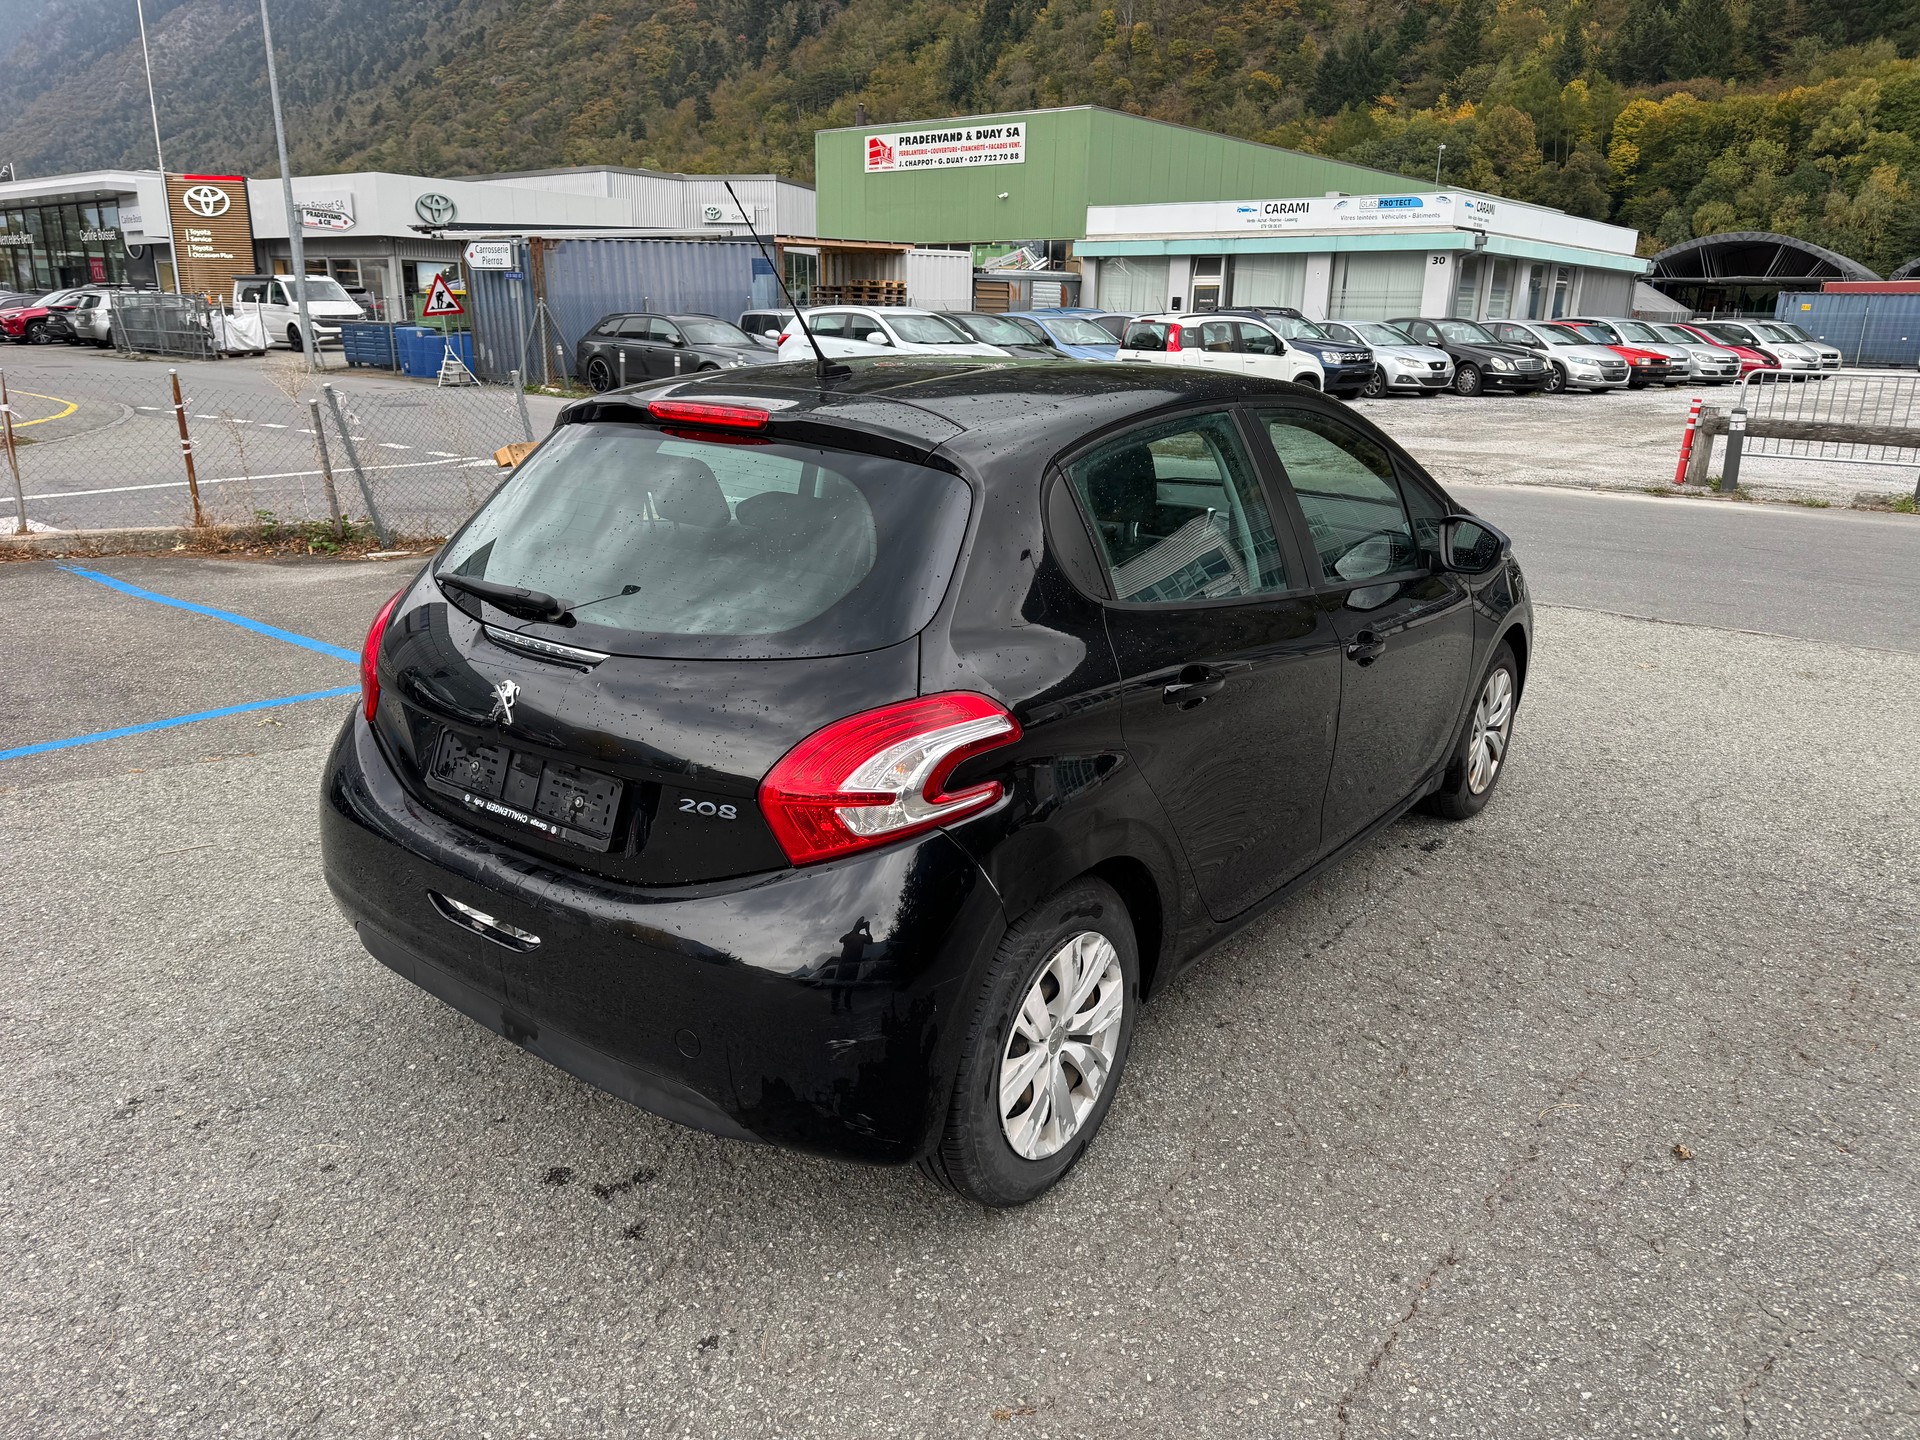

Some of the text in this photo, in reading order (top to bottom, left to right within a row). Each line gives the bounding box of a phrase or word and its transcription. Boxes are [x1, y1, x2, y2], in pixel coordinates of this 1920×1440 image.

[899, 126, 1020, 146] PRADERVAND & DUAY SA
[905, 158, 934, 167] CHAPPOT
[946, 156, 964, 164] DUAY
[969, 155, 982, 163] 027
[984, 154, 997, 162] 722
[999, 153, 1008, 161] 70
[1010, 152, 1019, 160] 88
[1264, 202, 1310, 215] CARAMI
[1361, 200, 1378, 208] GLAS
[1476, 201, 1496, 216] CARAMI
[1412, 211, 1441, 219] Bâtiments
[189, 228, 212, 236] Toyota
[191, 244, 214, 252] Toyota
[475, 244, 509, 254] Carrosserie
[481, 255, 503, 265] Pierroz
[1431, 256, 1446, 265] 30
[486, 801, 528, 823] CHALLENGER
[678, 798, 737, 820] 208
[529, 818, 548, 831] Garage
